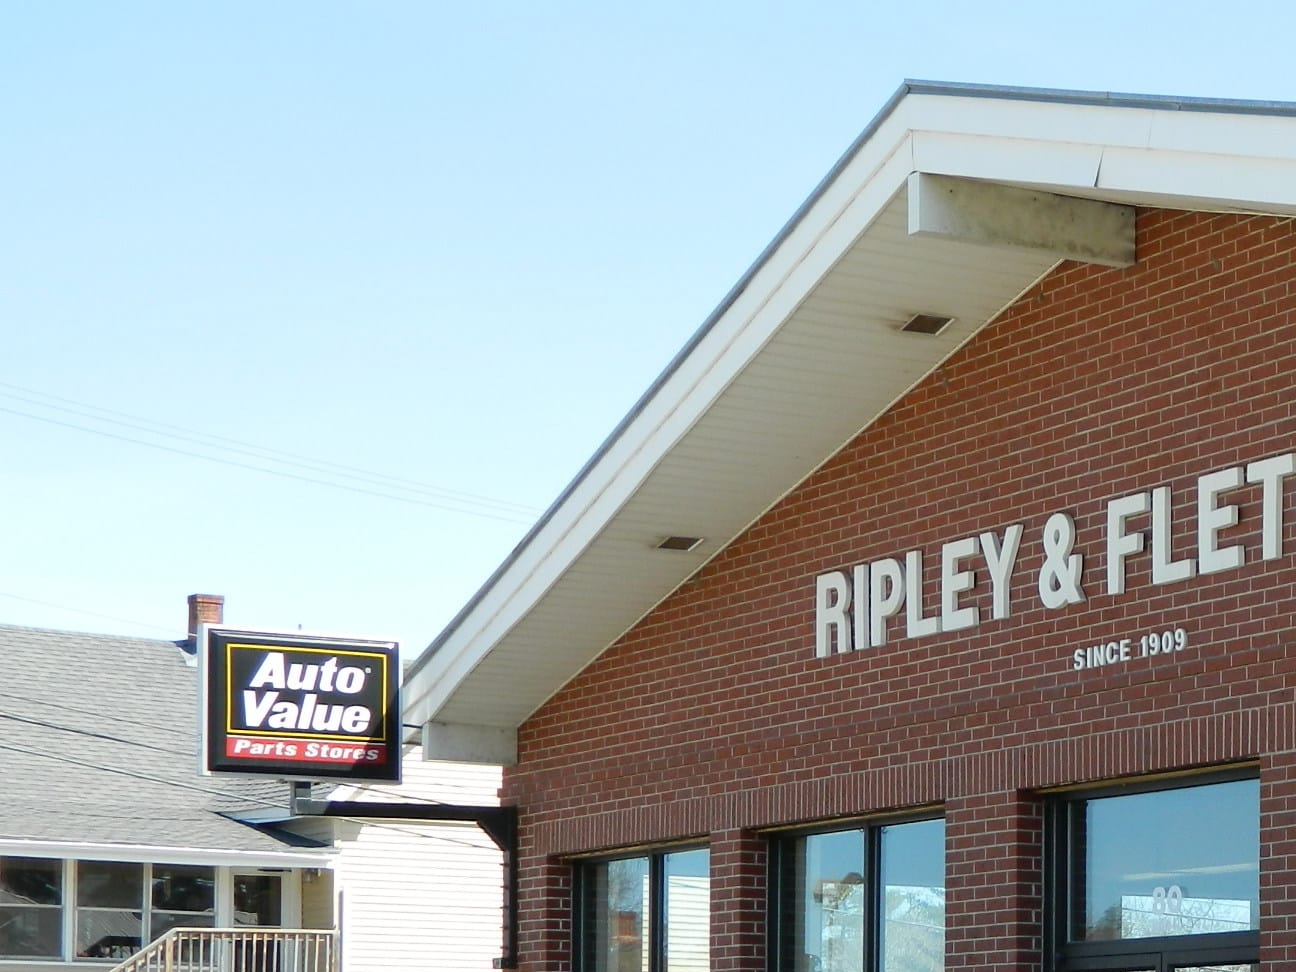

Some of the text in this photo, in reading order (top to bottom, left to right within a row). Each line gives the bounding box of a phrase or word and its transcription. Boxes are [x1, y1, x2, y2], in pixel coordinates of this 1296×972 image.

[815, 523, 1025, 659] RIPLEY
[1038, 512, 1086, 610] &
[1073, 628, 1188, 671] SINCE 1909
[249, 652, 366, 694] Auto
[243, 689, 371, 733] Value
[233, 739, 298, 757] Parts
[304, 743, 379, 761] Stores
